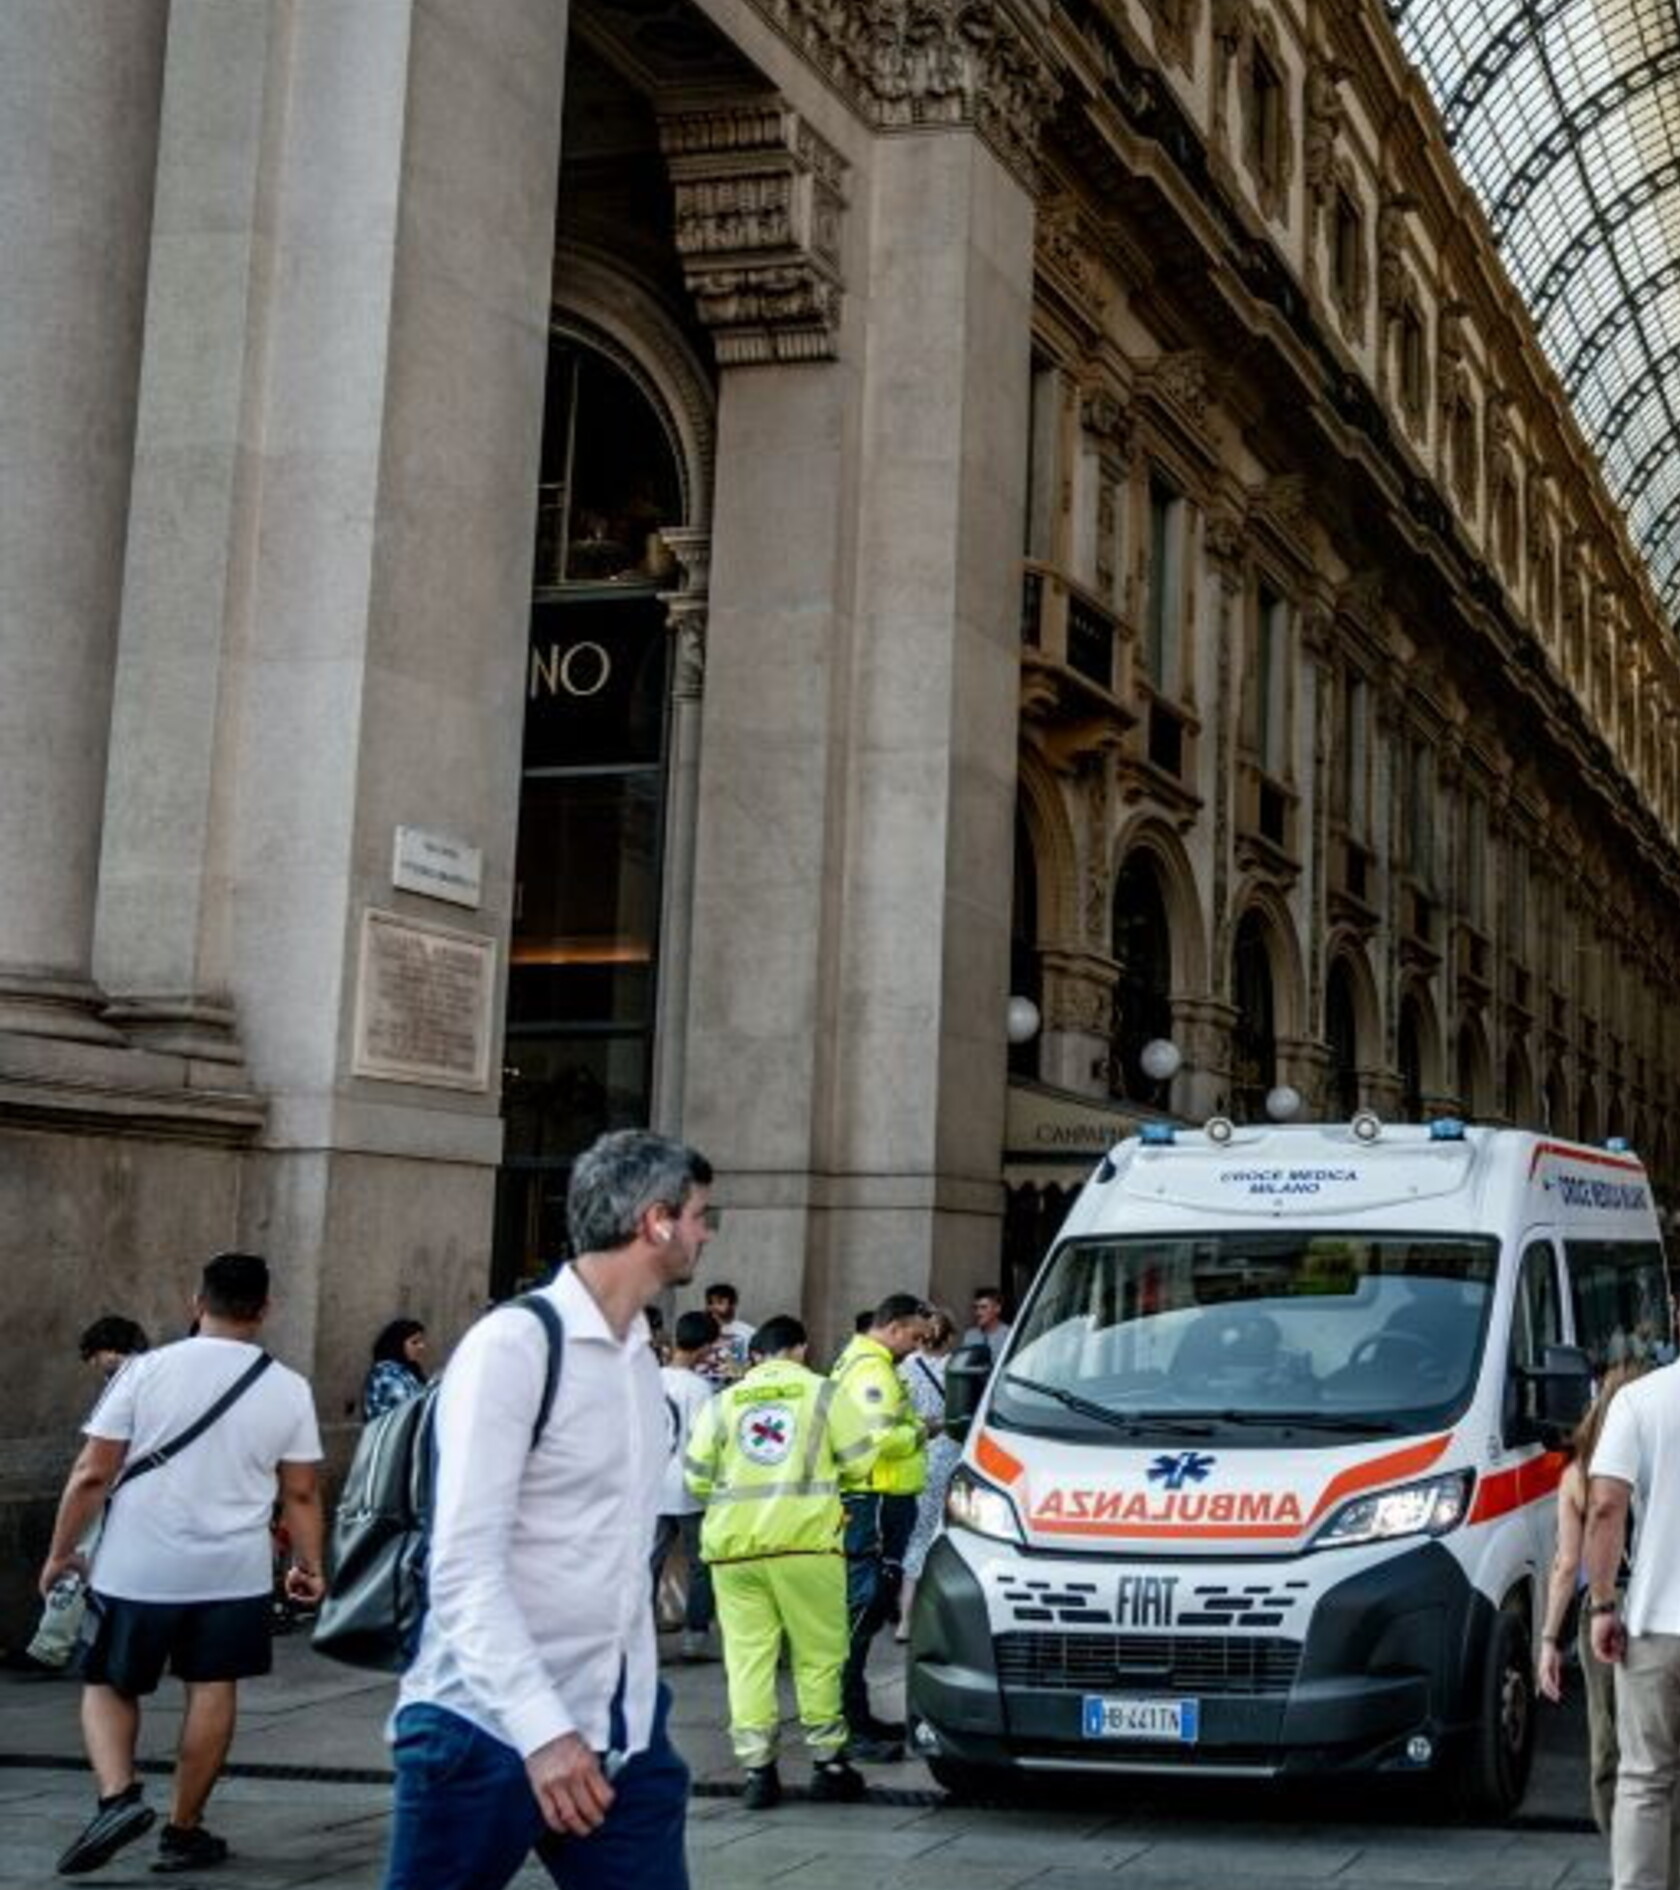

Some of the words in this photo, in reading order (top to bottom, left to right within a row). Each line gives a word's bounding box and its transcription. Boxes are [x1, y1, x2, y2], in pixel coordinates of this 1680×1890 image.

[530, 641, 611, 699] NO
[1249, 1182, 1320, 1195] MILANO
[1116, 1576, 1180, 1627] FIAT
